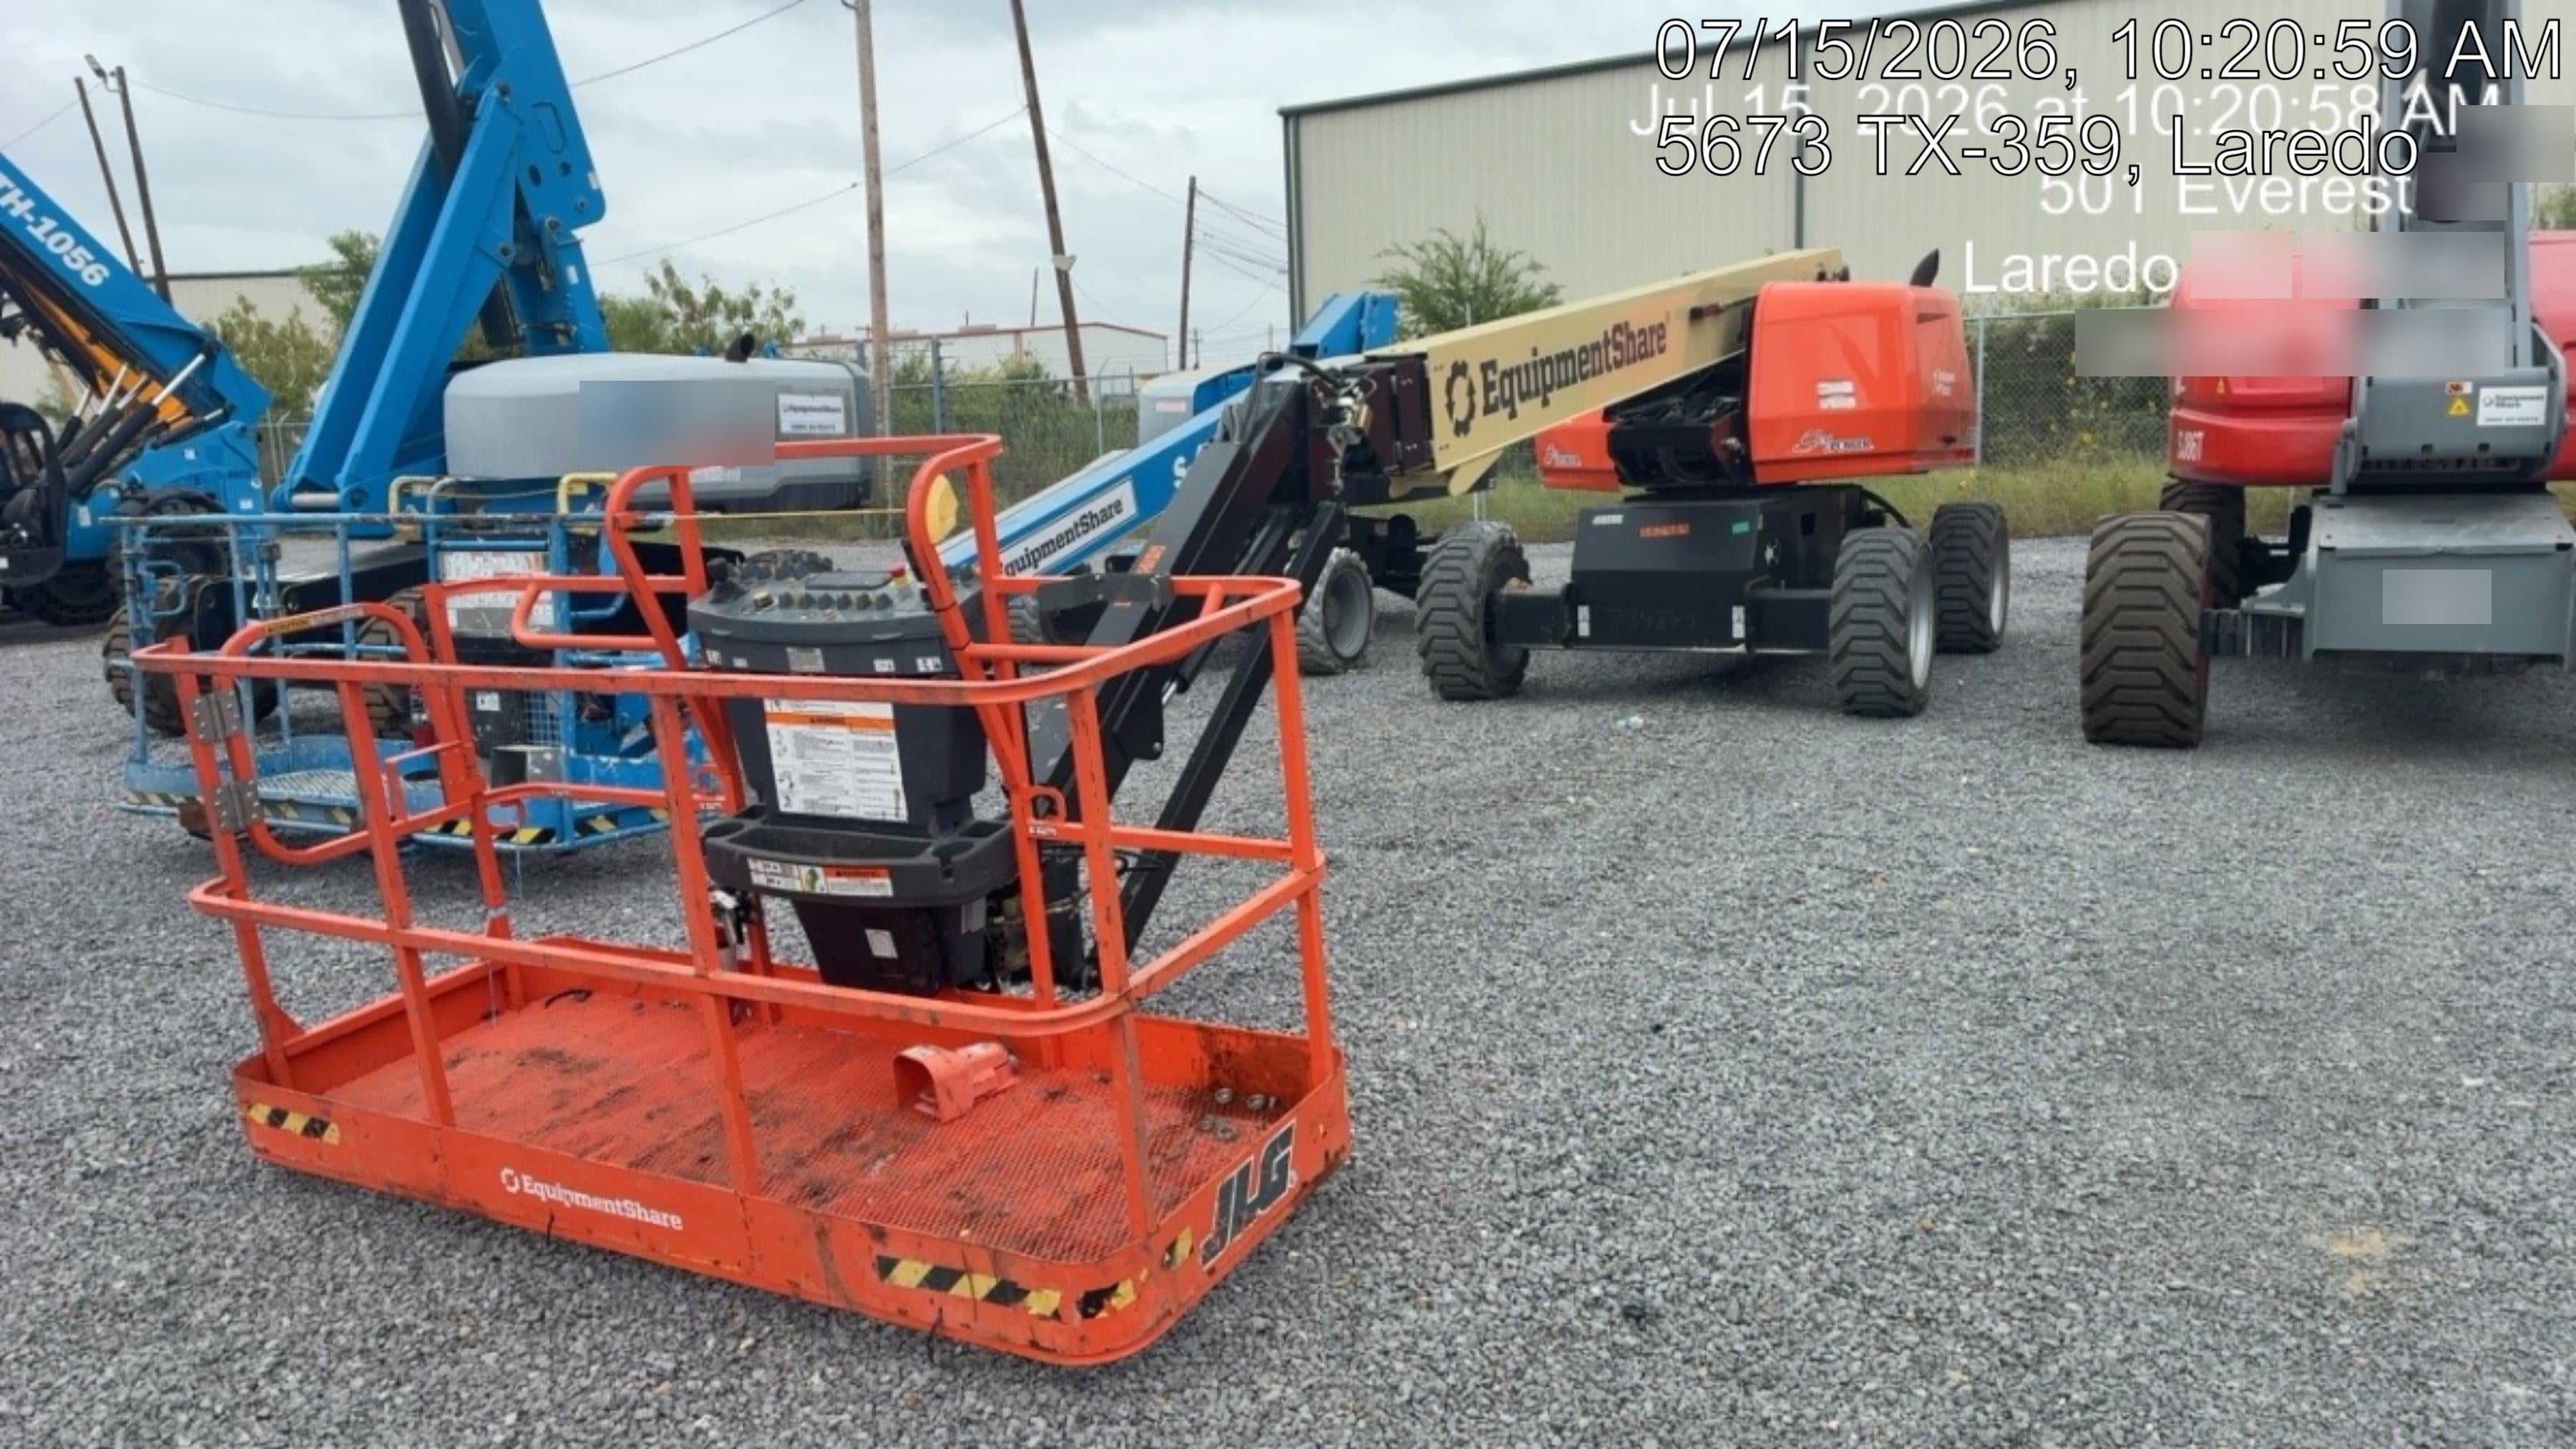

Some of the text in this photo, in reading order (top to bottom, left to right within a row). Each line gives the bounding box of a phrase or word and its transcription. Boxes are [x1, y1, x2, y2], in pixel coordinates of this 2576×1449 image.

[1480, 321, 1667, 421] EquipmentShare
[1000, 499, 1123, 577] quipmentShare
[521, 1173, 683, 1231] EquipmentShare
[1200, 1118, 1297, 1272] JLG
